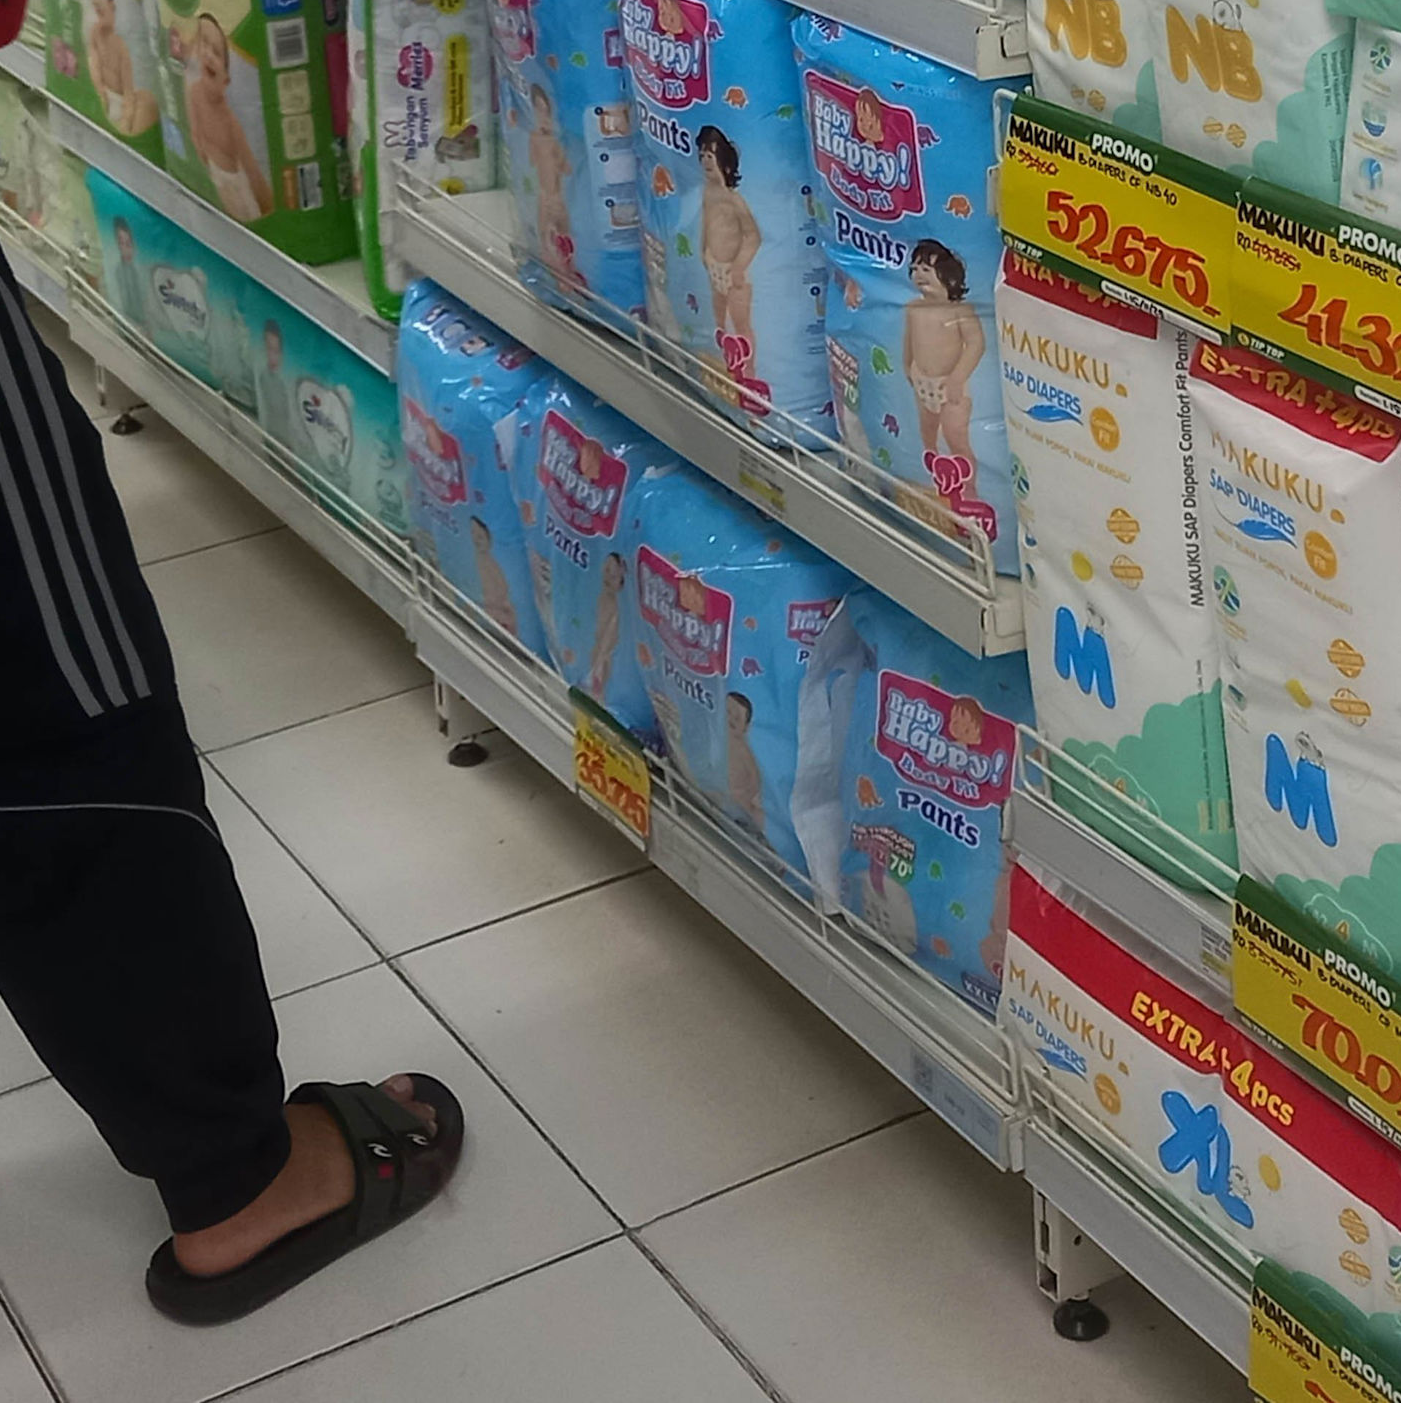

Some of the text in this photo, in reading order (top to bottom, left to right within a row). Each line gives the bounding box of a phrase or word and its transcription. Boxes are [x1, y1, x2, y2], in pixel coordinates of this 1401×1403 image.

[1166, 3, 1263, 100] NB
[637, 100, 692, 155] Pants
[814, 97, 852, 135] Baby
[1010, 116, 1076, 160] MAKUKU
[816, 124, 909, 190] Happy!
[1091, 133, 1154, 174] PROMO
[835, 210, 908, 268] Pants
[1237, 201, 1326, 258] MAKUKU
[543, 515, 590, 570] Pants
[1053, 606, 1116, 710] M
[888, 690, 938, 732] Baby
[885, 715, 1005, 787] Happy!
[899, 752, 950, 790] Body
[897, 787, 981, 849] Pants
[1265, 733, 1339, 848] M
[1235, 902, 1311, 973] MAKUKU
[1324, 947, 1394, 1008] PROMO
[1008, 962, 1116, 1063] MAKUKU
[1130, 990, 1218, 1073] EXTRA
[1158, 1089, 1255, 1230] XL
